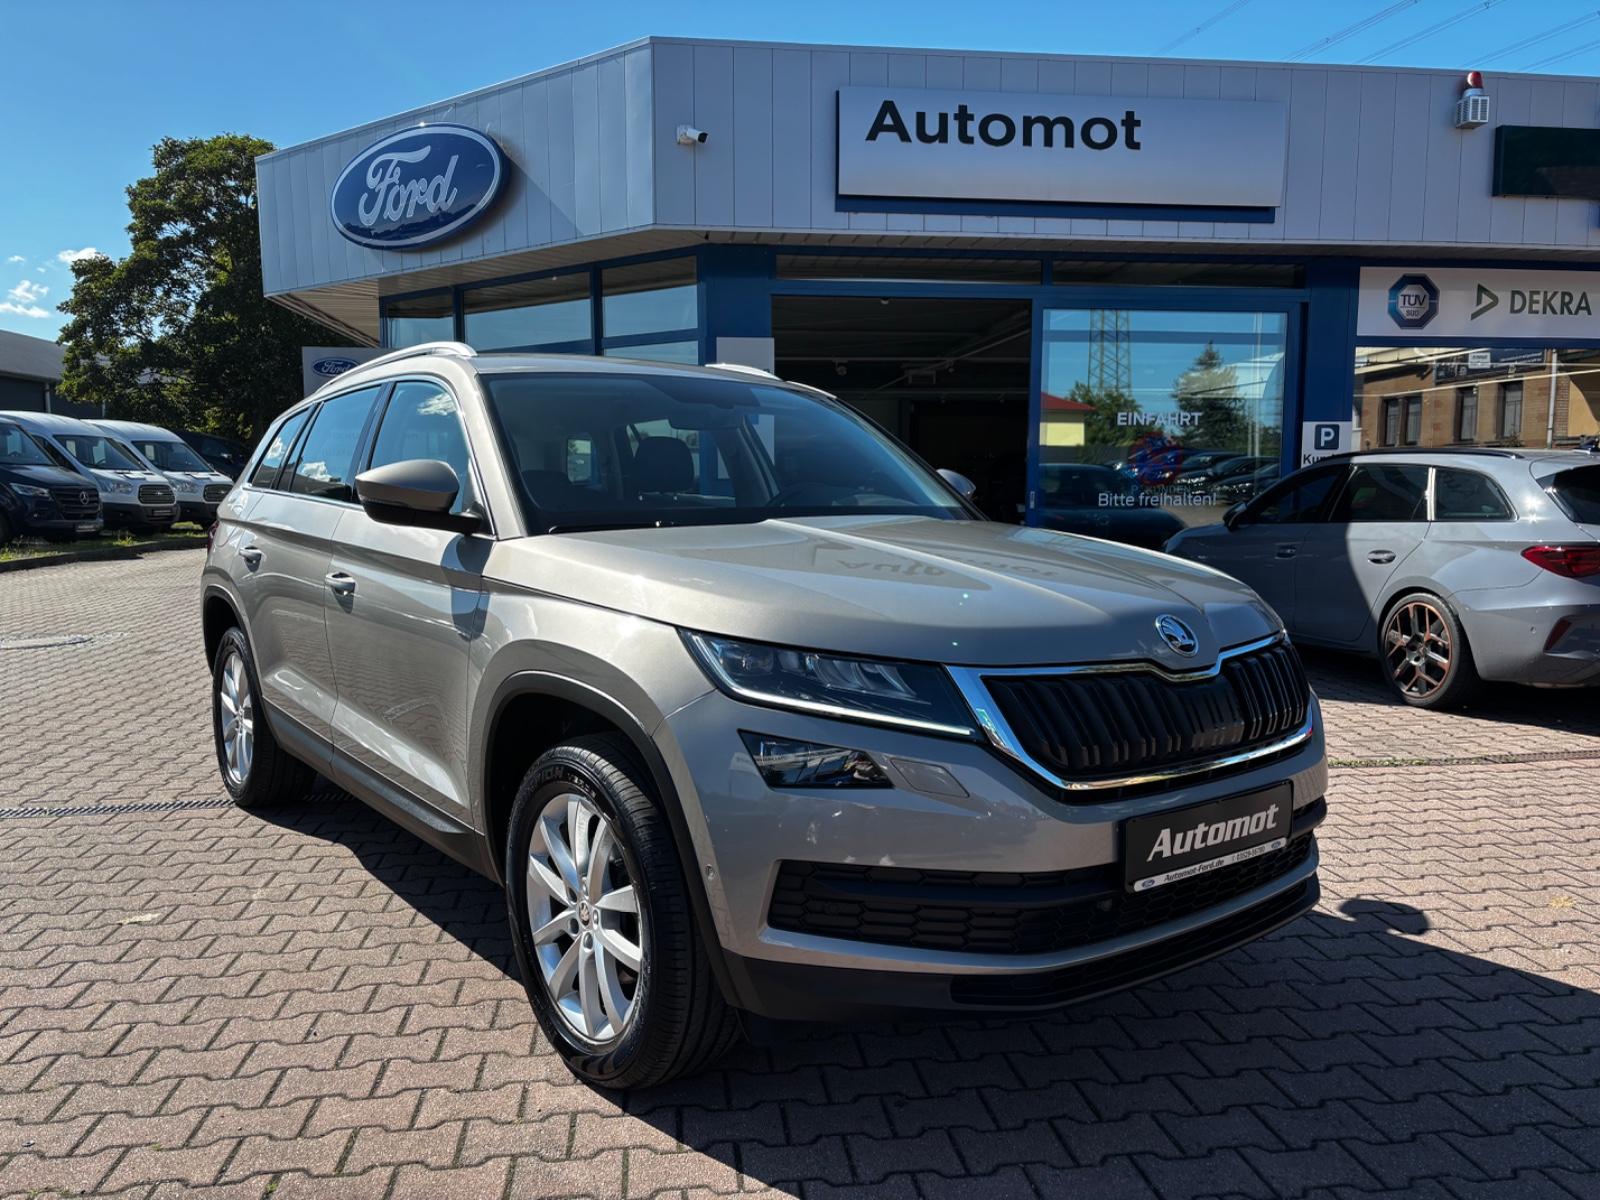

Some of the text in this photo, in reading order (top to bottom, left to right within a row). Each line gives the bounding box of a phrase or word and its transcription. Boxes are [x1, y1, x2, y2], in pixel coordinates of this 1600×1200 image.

[865, 99, 1142, 151] Automot
[358, 145, 459, 227] Ford
[1400, 293, 1428, 306] TÜV
[1509, 289, 1593, 316] DEKRA
[321, 360, 352, 374] Ford
[1116, 411, 1203, 427] EINFAHRT
[1320, 427, 1335, 447] P
[1098, 491, 1217, 507] Bitte freihalten!
[1146, 803, 1280, 862] Automot
